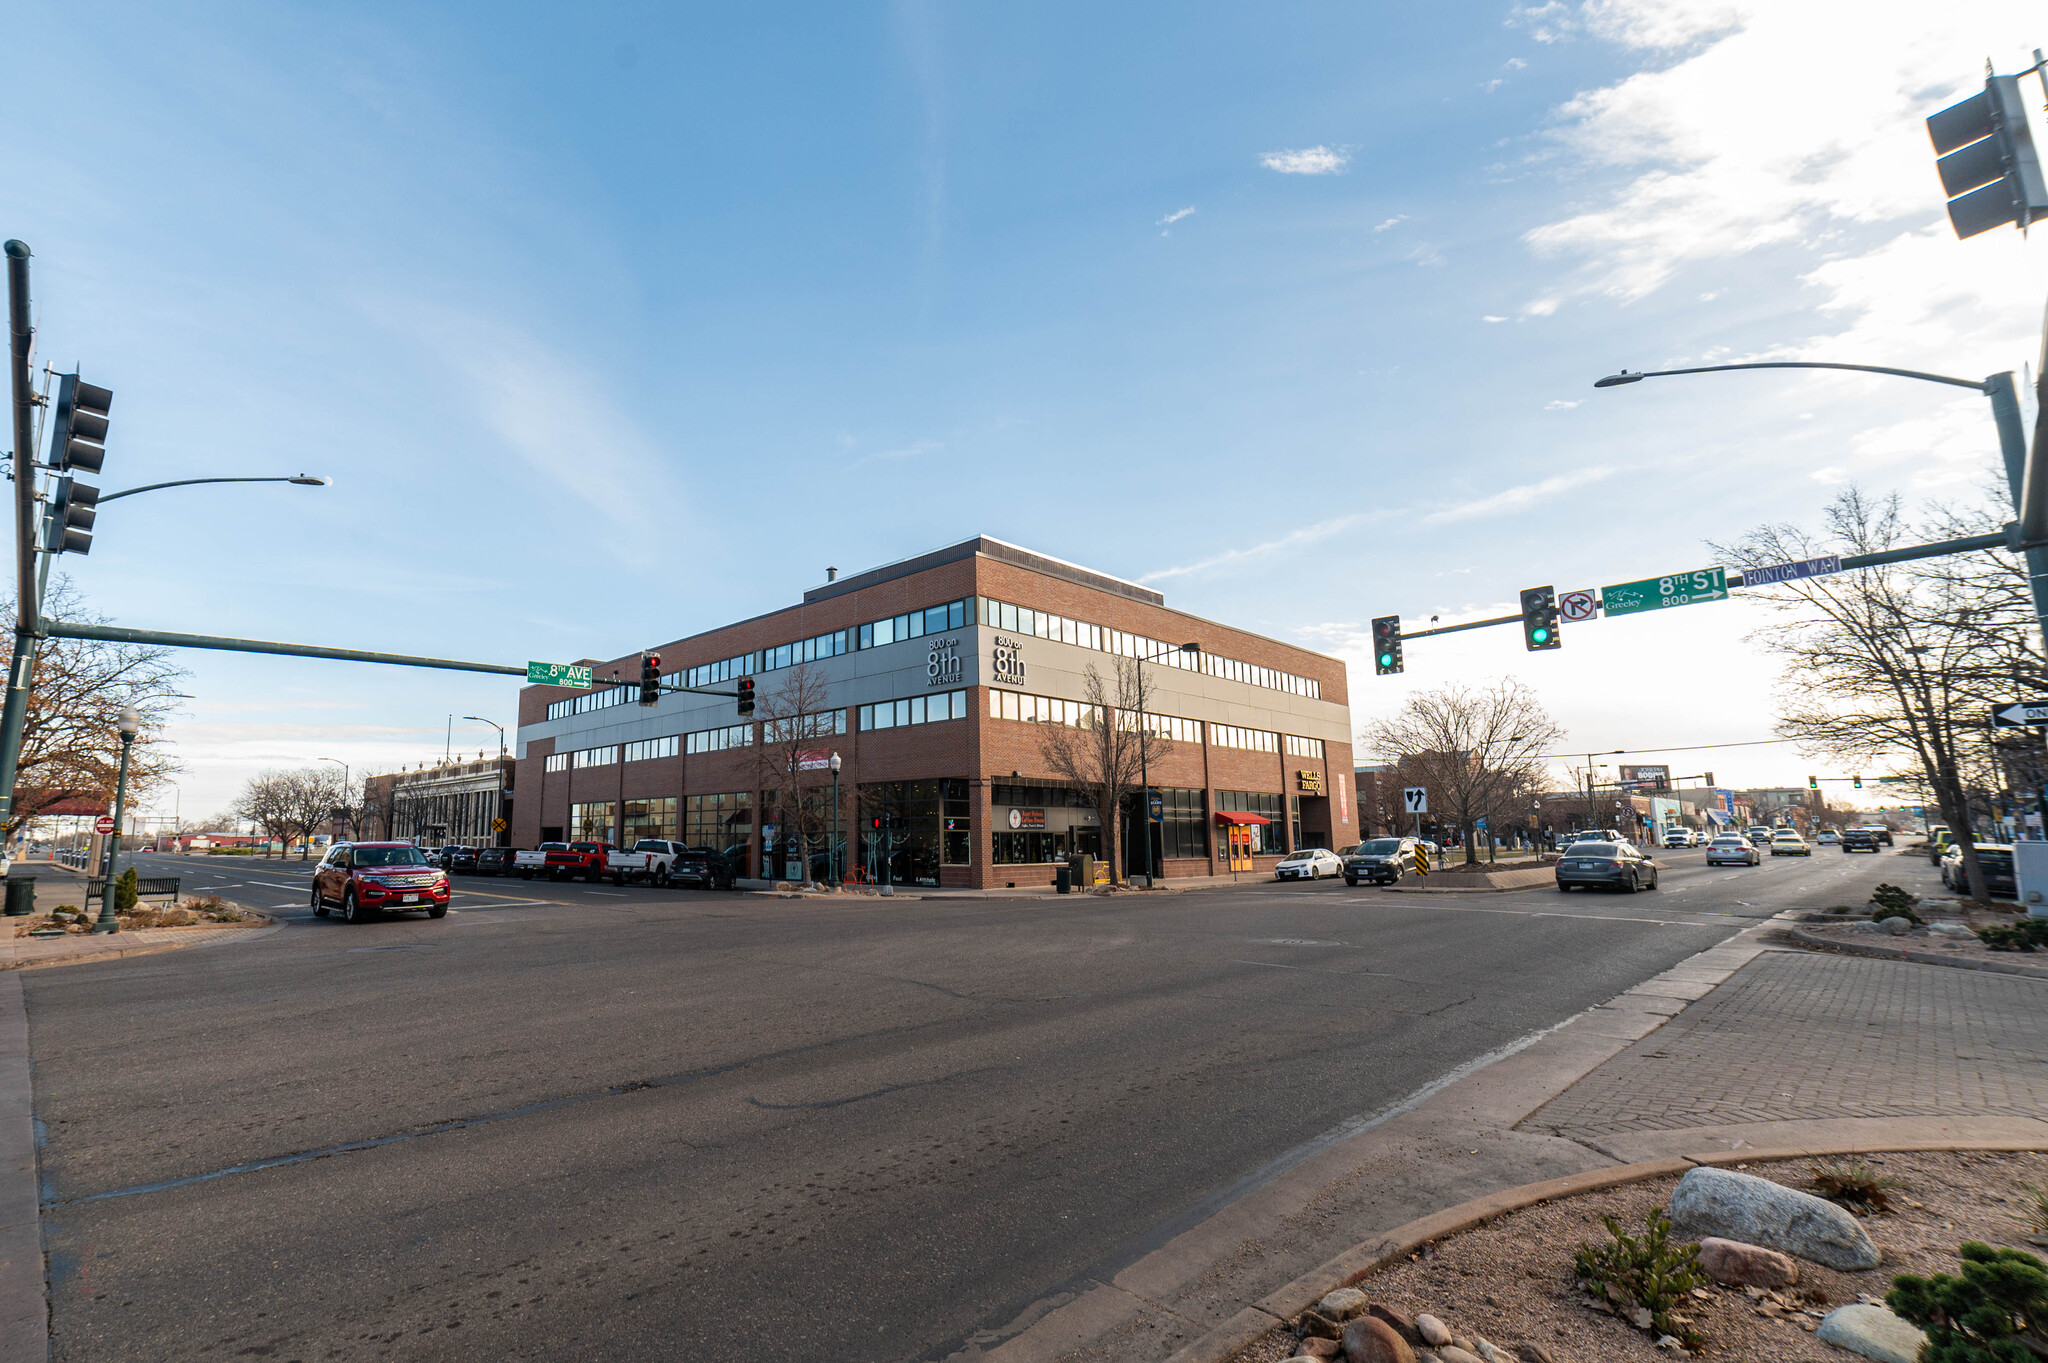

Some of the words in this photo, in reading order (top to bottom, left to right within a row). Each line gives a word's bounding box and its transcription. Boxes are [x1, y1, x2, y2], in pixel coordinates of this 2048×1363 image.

[1806, 557, 1836, 575] WAY
[1659, 574, 1689, 596] 8TH
[1692, 568, 1722, 590] ST
[1605, 599, 1641, 610] Greeley
[1662, 594, 1689, 607] 800
[929, 638, 945, 651] 800
[946, 638, 957, 647] on
[998, 635, 1013, 646] 800
[1014, 640, 1024, 649] on
[927, 647, 960, 677] 8th
[996, 647, 1027, 676] 8th
[550, 664, 566, 677] 8TH
[567, 667, 590, 680] AVE
[559, 678, 573, 686] 800
[927, 674, 961, 686] AVENUE
[1301, 770, 1321, 780] WELLS
[1302, 780, 1322, 790] FARGO
